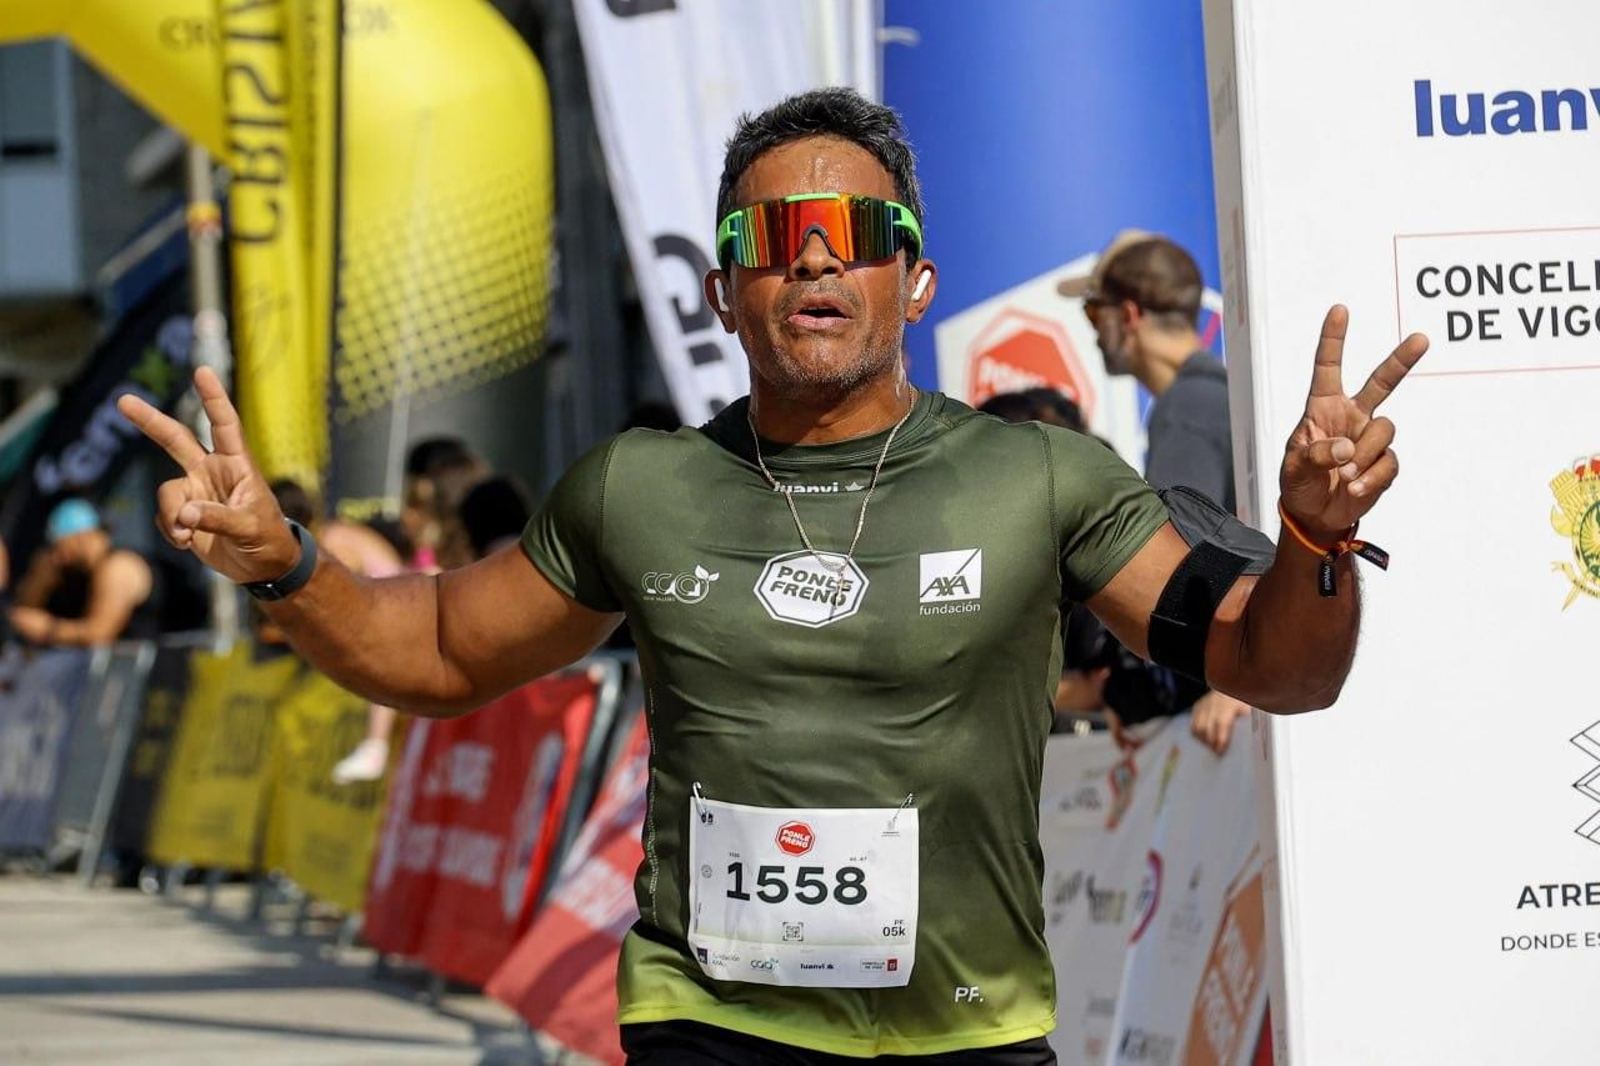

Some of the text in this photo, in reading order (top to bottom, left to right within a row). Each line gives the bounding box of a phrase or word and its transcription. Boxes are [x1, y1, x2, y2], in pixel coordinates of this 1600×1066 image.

[1414, 79, 1600, 137] luan
[1447, 305, 1600, 342] DE VIG
[770, 580, 847, 607] FRENO
[920, 575, 970, 598] AXA
[920, 601, 981, 616] fundación
[781, 829, 811, 842] PONLE
[727, 861, 868, 905] 1558
[882, 926, 906, 937] 05k
[1501, 931, 1600, 951] DONDE E
[955, 986, 984, 1003] PF.
